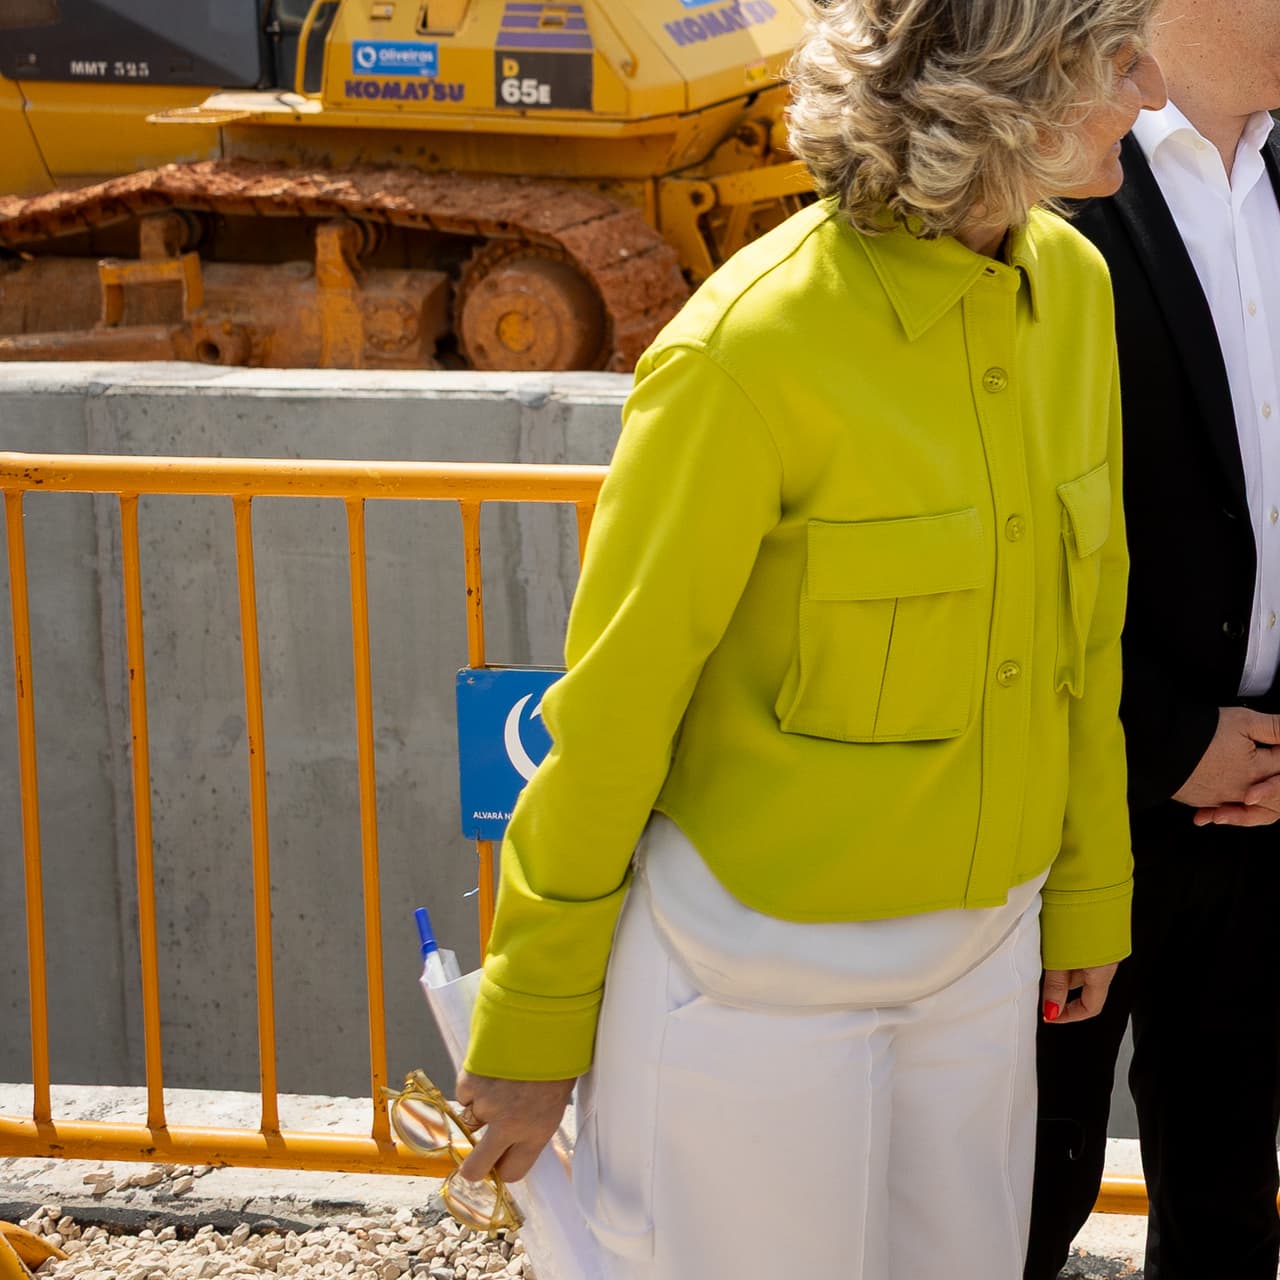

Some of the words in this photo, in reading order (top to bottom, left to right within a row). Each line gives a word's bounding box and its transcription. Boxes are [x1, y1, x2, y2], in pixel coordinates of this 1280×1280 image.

[71, 60, 107, 76] MMT
[502, 59, 520, 77] D
[345, 78, 464, 102] KOMATSU
[501, 78, 551, 104] 65E
